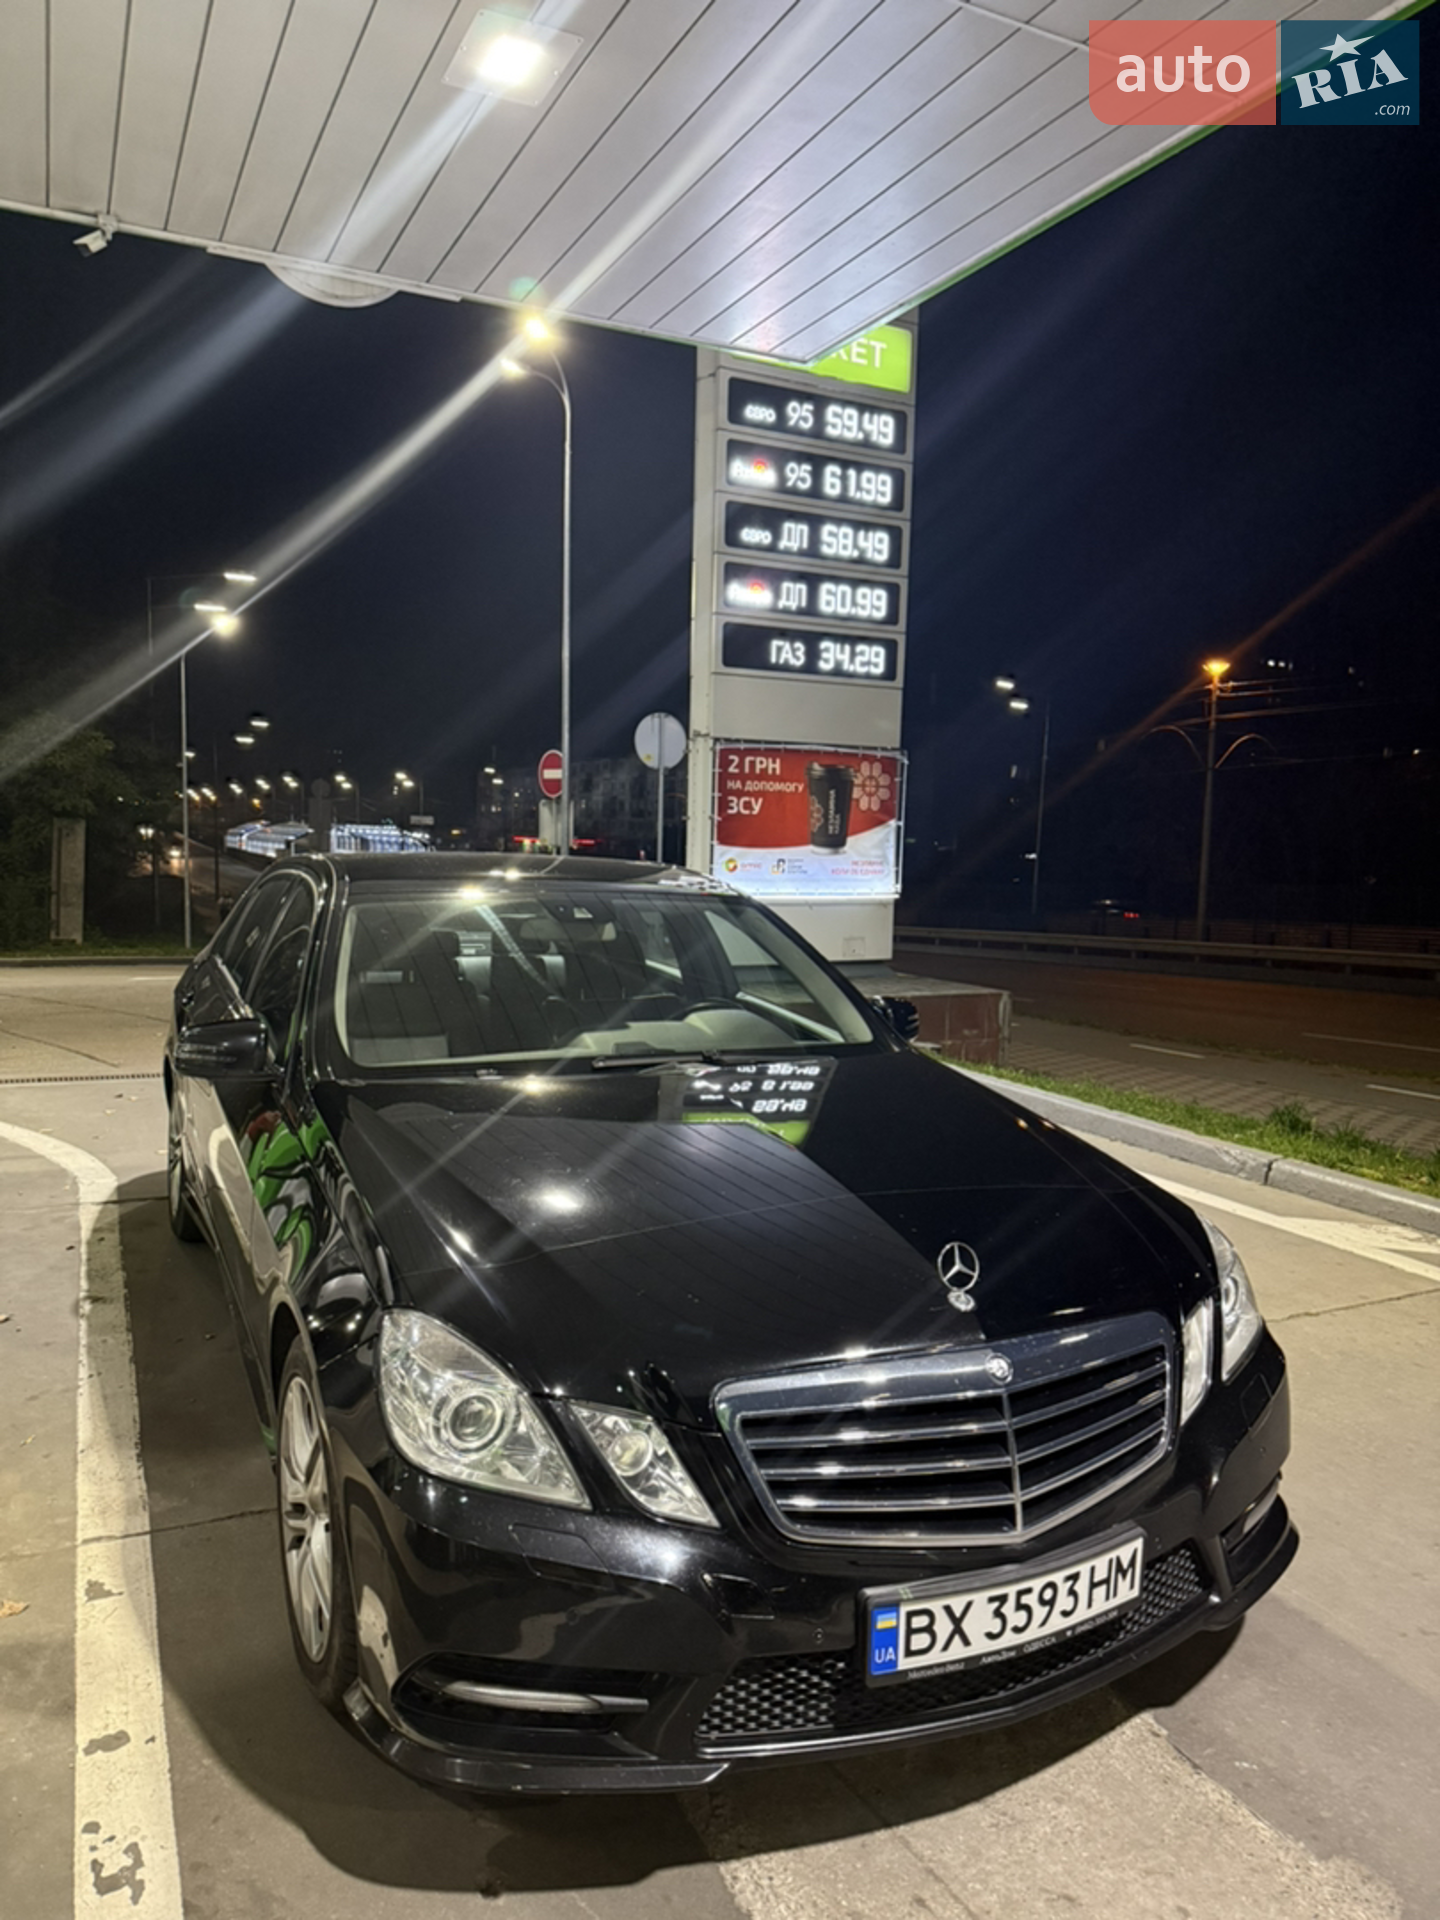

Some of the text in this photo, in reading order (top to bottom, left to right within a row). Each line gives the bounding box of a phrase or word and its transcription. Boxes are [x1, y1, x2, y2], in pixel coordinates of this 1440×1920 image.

[785, 401, 814, 429] 95
[825, 406, 895, 446] 59.49
[784, 462, 813, 490] 95
[823, 465, 893, 505] 61.99
[820, 525, 891, 563] 58.49
[818, 582, 888, 620] 60.99
[769, 639, 886, 676] ГАЗ 34.29
[727, 755, 781, 775] 2 ГРН
[727, 780, 805, 793] НА ДОПОМОГУ
[727, 796, 763, 815] ЗСУ
[903, 1600, 974, 1659] BX
[984, 1570, 1082, 1641] 3593
[1086, 1547, 1138, 1610] HM
[874, 1645, 897, 1664] UA
